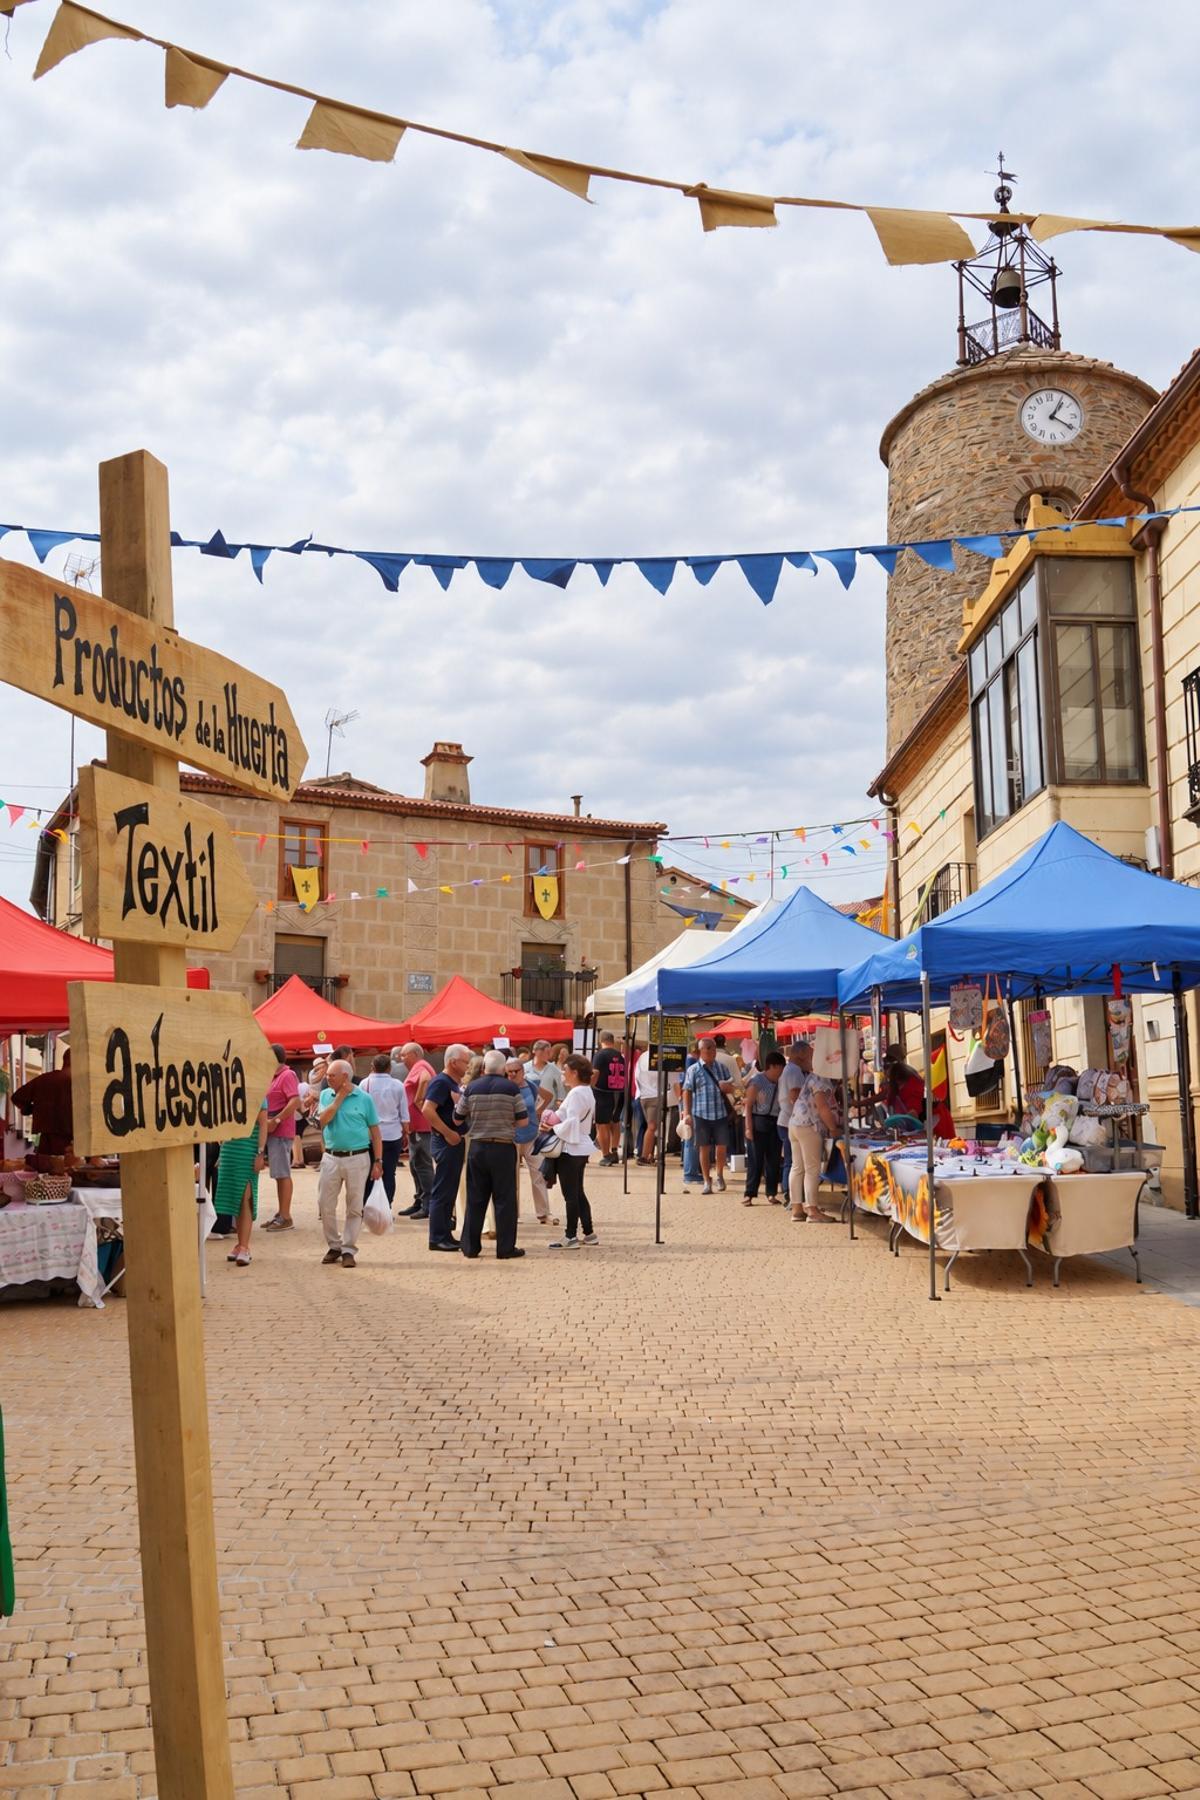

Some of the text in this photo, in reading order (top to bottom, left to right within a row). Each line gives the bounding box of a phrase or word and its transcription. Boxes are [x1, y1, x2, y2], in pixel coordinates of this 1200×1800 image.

[53, 592, 289, 791] Productos de la Huerta
[114, 802, 218, 932] Textil
